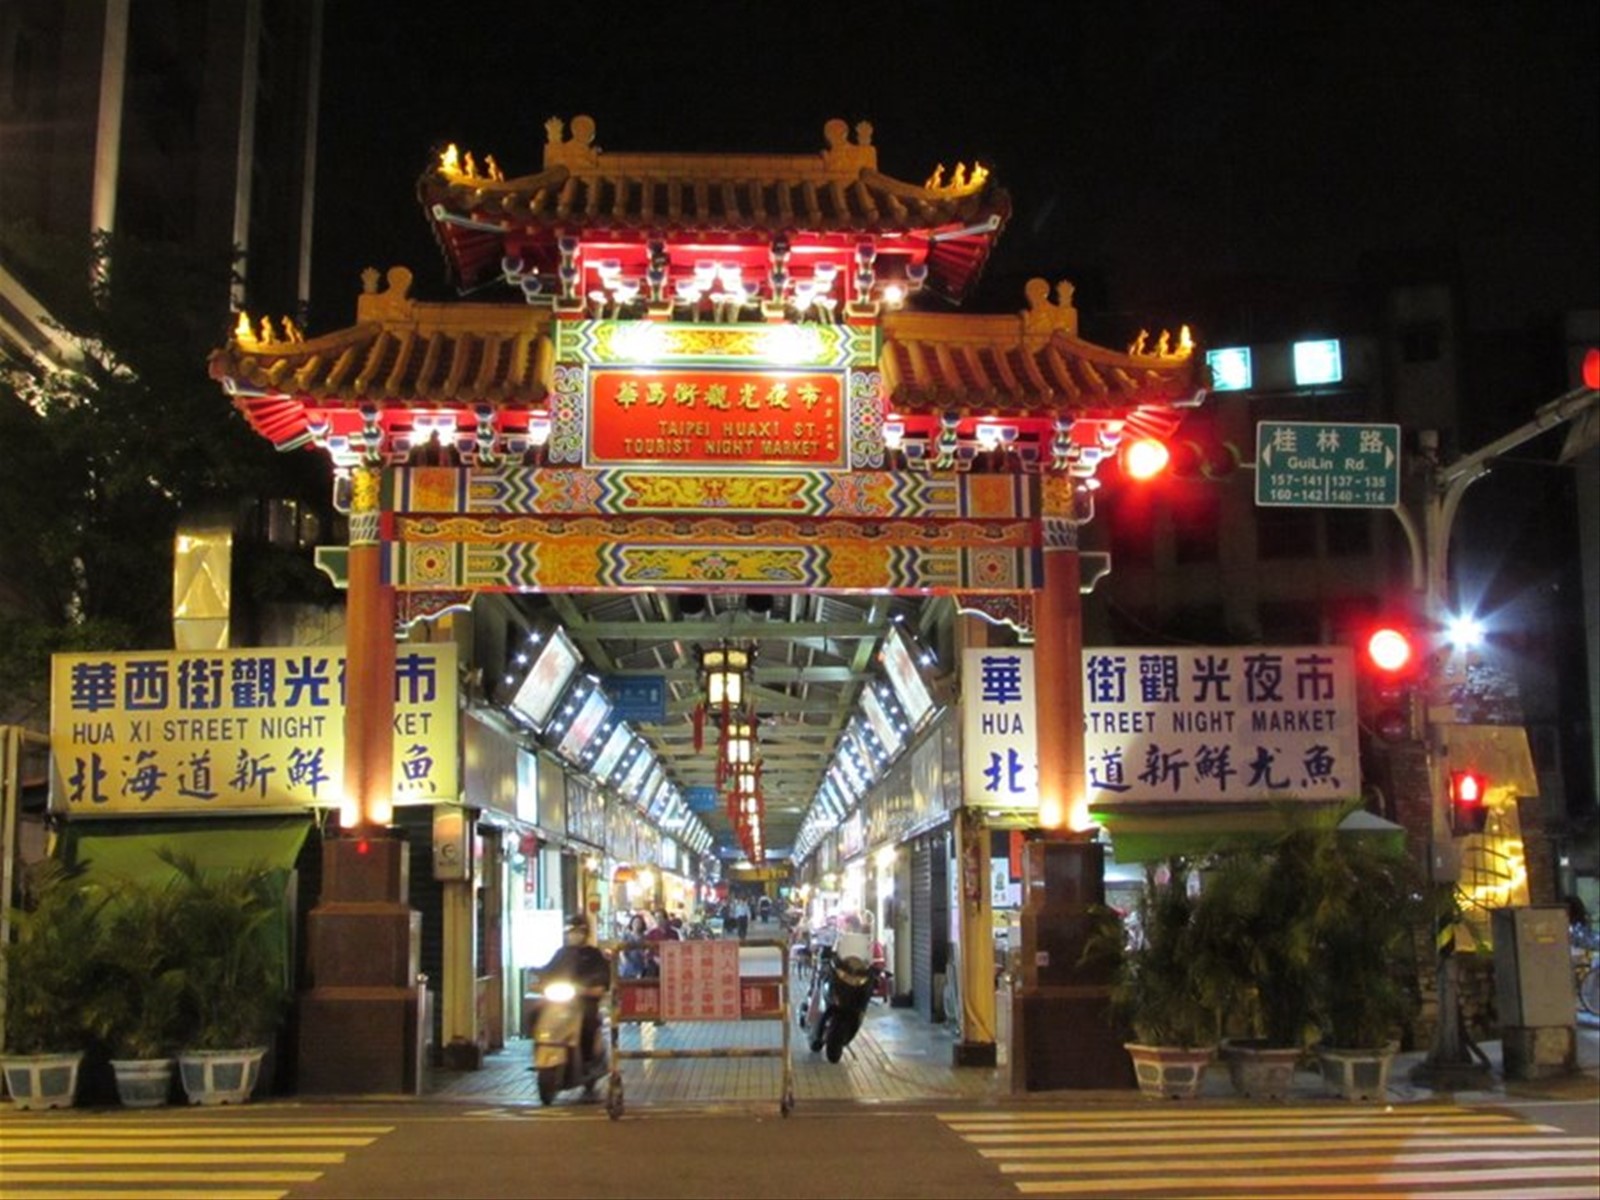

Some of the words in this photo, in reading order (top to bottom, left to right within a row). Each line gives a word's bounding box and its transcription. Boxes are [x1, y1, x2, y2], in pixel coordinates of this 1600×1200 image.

[658, 420, 710, 436] TAIPEI
[723, 421, 779, 437] HUAXI
[1273, 427, 1384, 453] 桂林路
[624, 438, 692, 454] TOURIST
[705, 440, 753, 455] NIGHT
[760, 441, 820, 456] MARKET
[1287, 457, 1334, 470] GuiLin
[70, 653, 437, 712] 華西街觀光市
[981, 654, 1335, 705] 華街觀光夜市
[72, 722, 115, 745] HUA
[129, 721, 151, 743] XI
[163, 718, 249, 742] STREET
[260, 716, 326, 738] NIGHT
[981, 712, 1024, 735] HUA
[1172, 711, 1235, 733] NIGHT
[1251, 709, 1336, 732] MARKET
[68, 744, 437, 803] 北海道新鮮魚
[983, 743, 1341, 794] 北道新鮮尤魚
